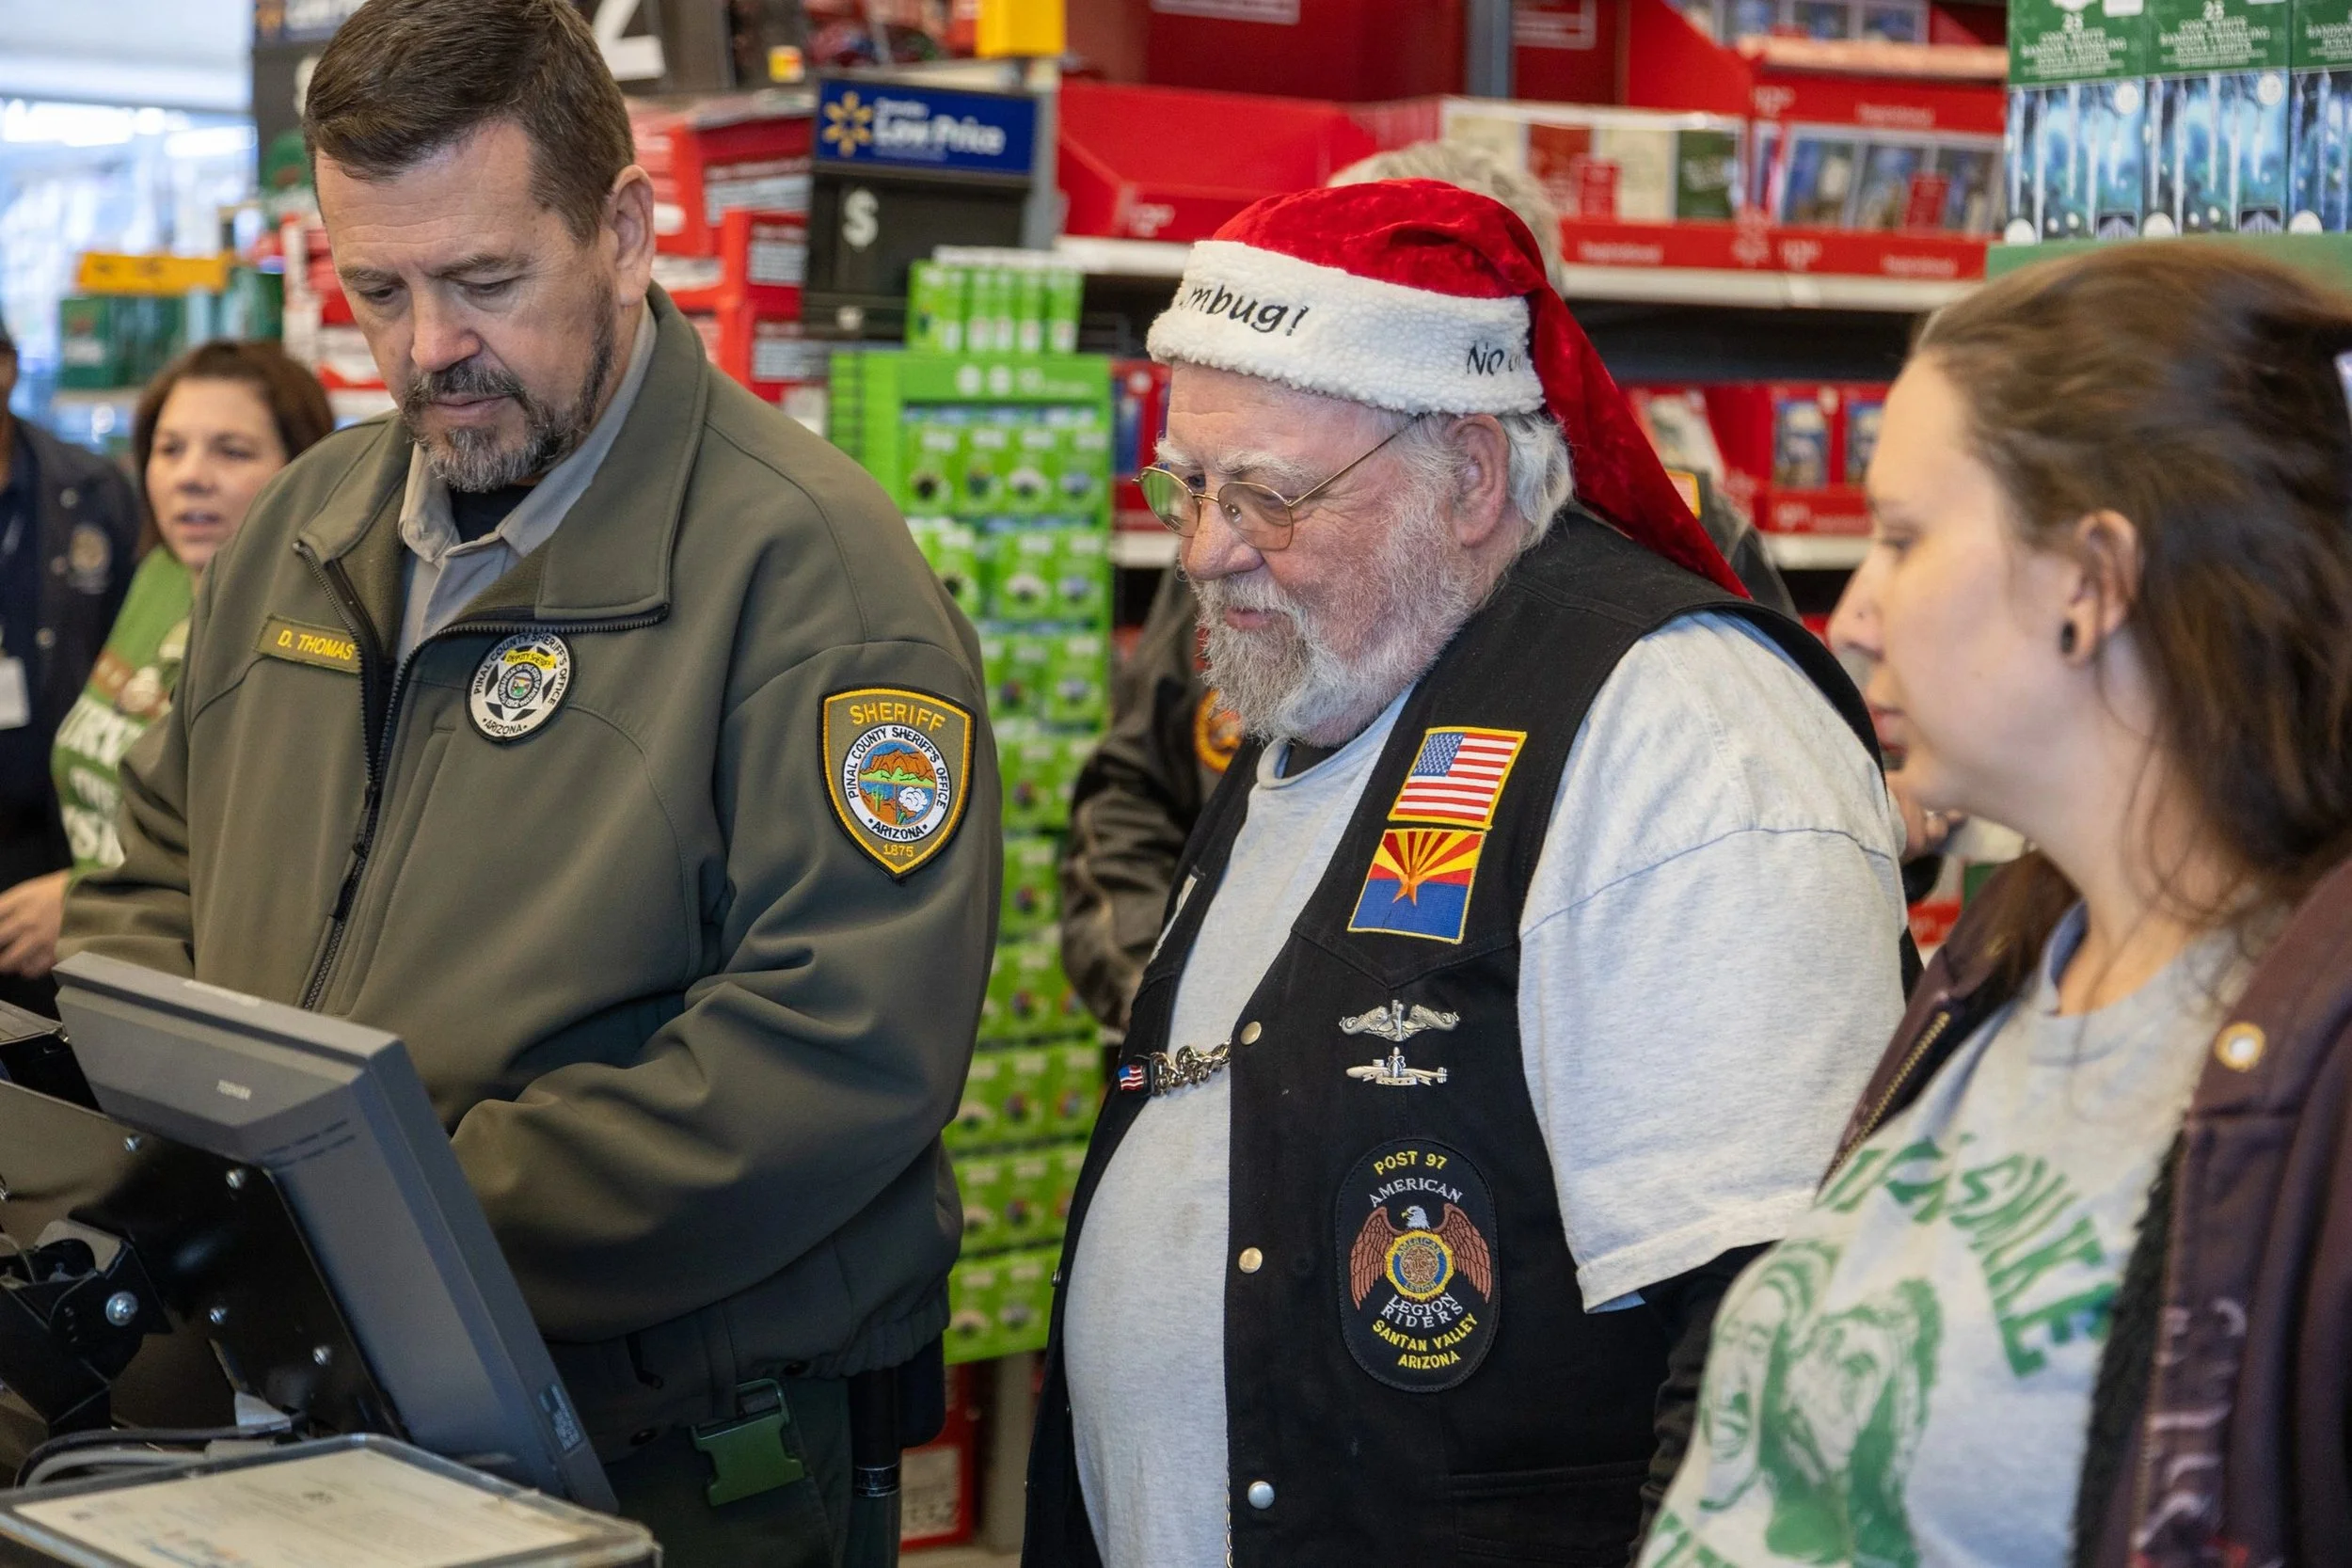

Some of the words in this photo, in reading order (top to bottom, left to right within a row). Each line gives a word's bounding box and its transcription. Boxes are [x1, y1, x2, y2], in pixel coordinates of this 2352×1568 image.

[277, 628, 294, 648] D.
[296, 632, 356, 661] THOMAS
[473, 662, 493, 695] PINAL
[490, 633, 531, 661] COUNTY
[548, 668, 568, 705] OFFICE
[484, 719, 524, 736] ARIZONA
[849, 702, 946, 732] SHERIFF
[850, 728, 887, 761] COUNTY
[891, 727, 941, 764] SHERIFF'S
[845, 761, 859, 800] PINAL
[935, 766, 951, 810] OFFICE
[871, 822, 925, 841] ARIZONA
[882, 844, 914, 858] 1875
[1373, 1150, 1419, 1176] POST
[1424, 1152, 1448, 1170] 97
[1368, 1177, 1464, 1208] AMERICAN
[1380, 1302, 1464, 1328] RIDERS
[1388, 1291, 1458, 1316] LEGION
[1372, 1319, 1427, 1352] SANTAN
[1431, 1312, 1478, 1350] VALLEY
[1397, 1350, 1462, 1370] ARIZONA
